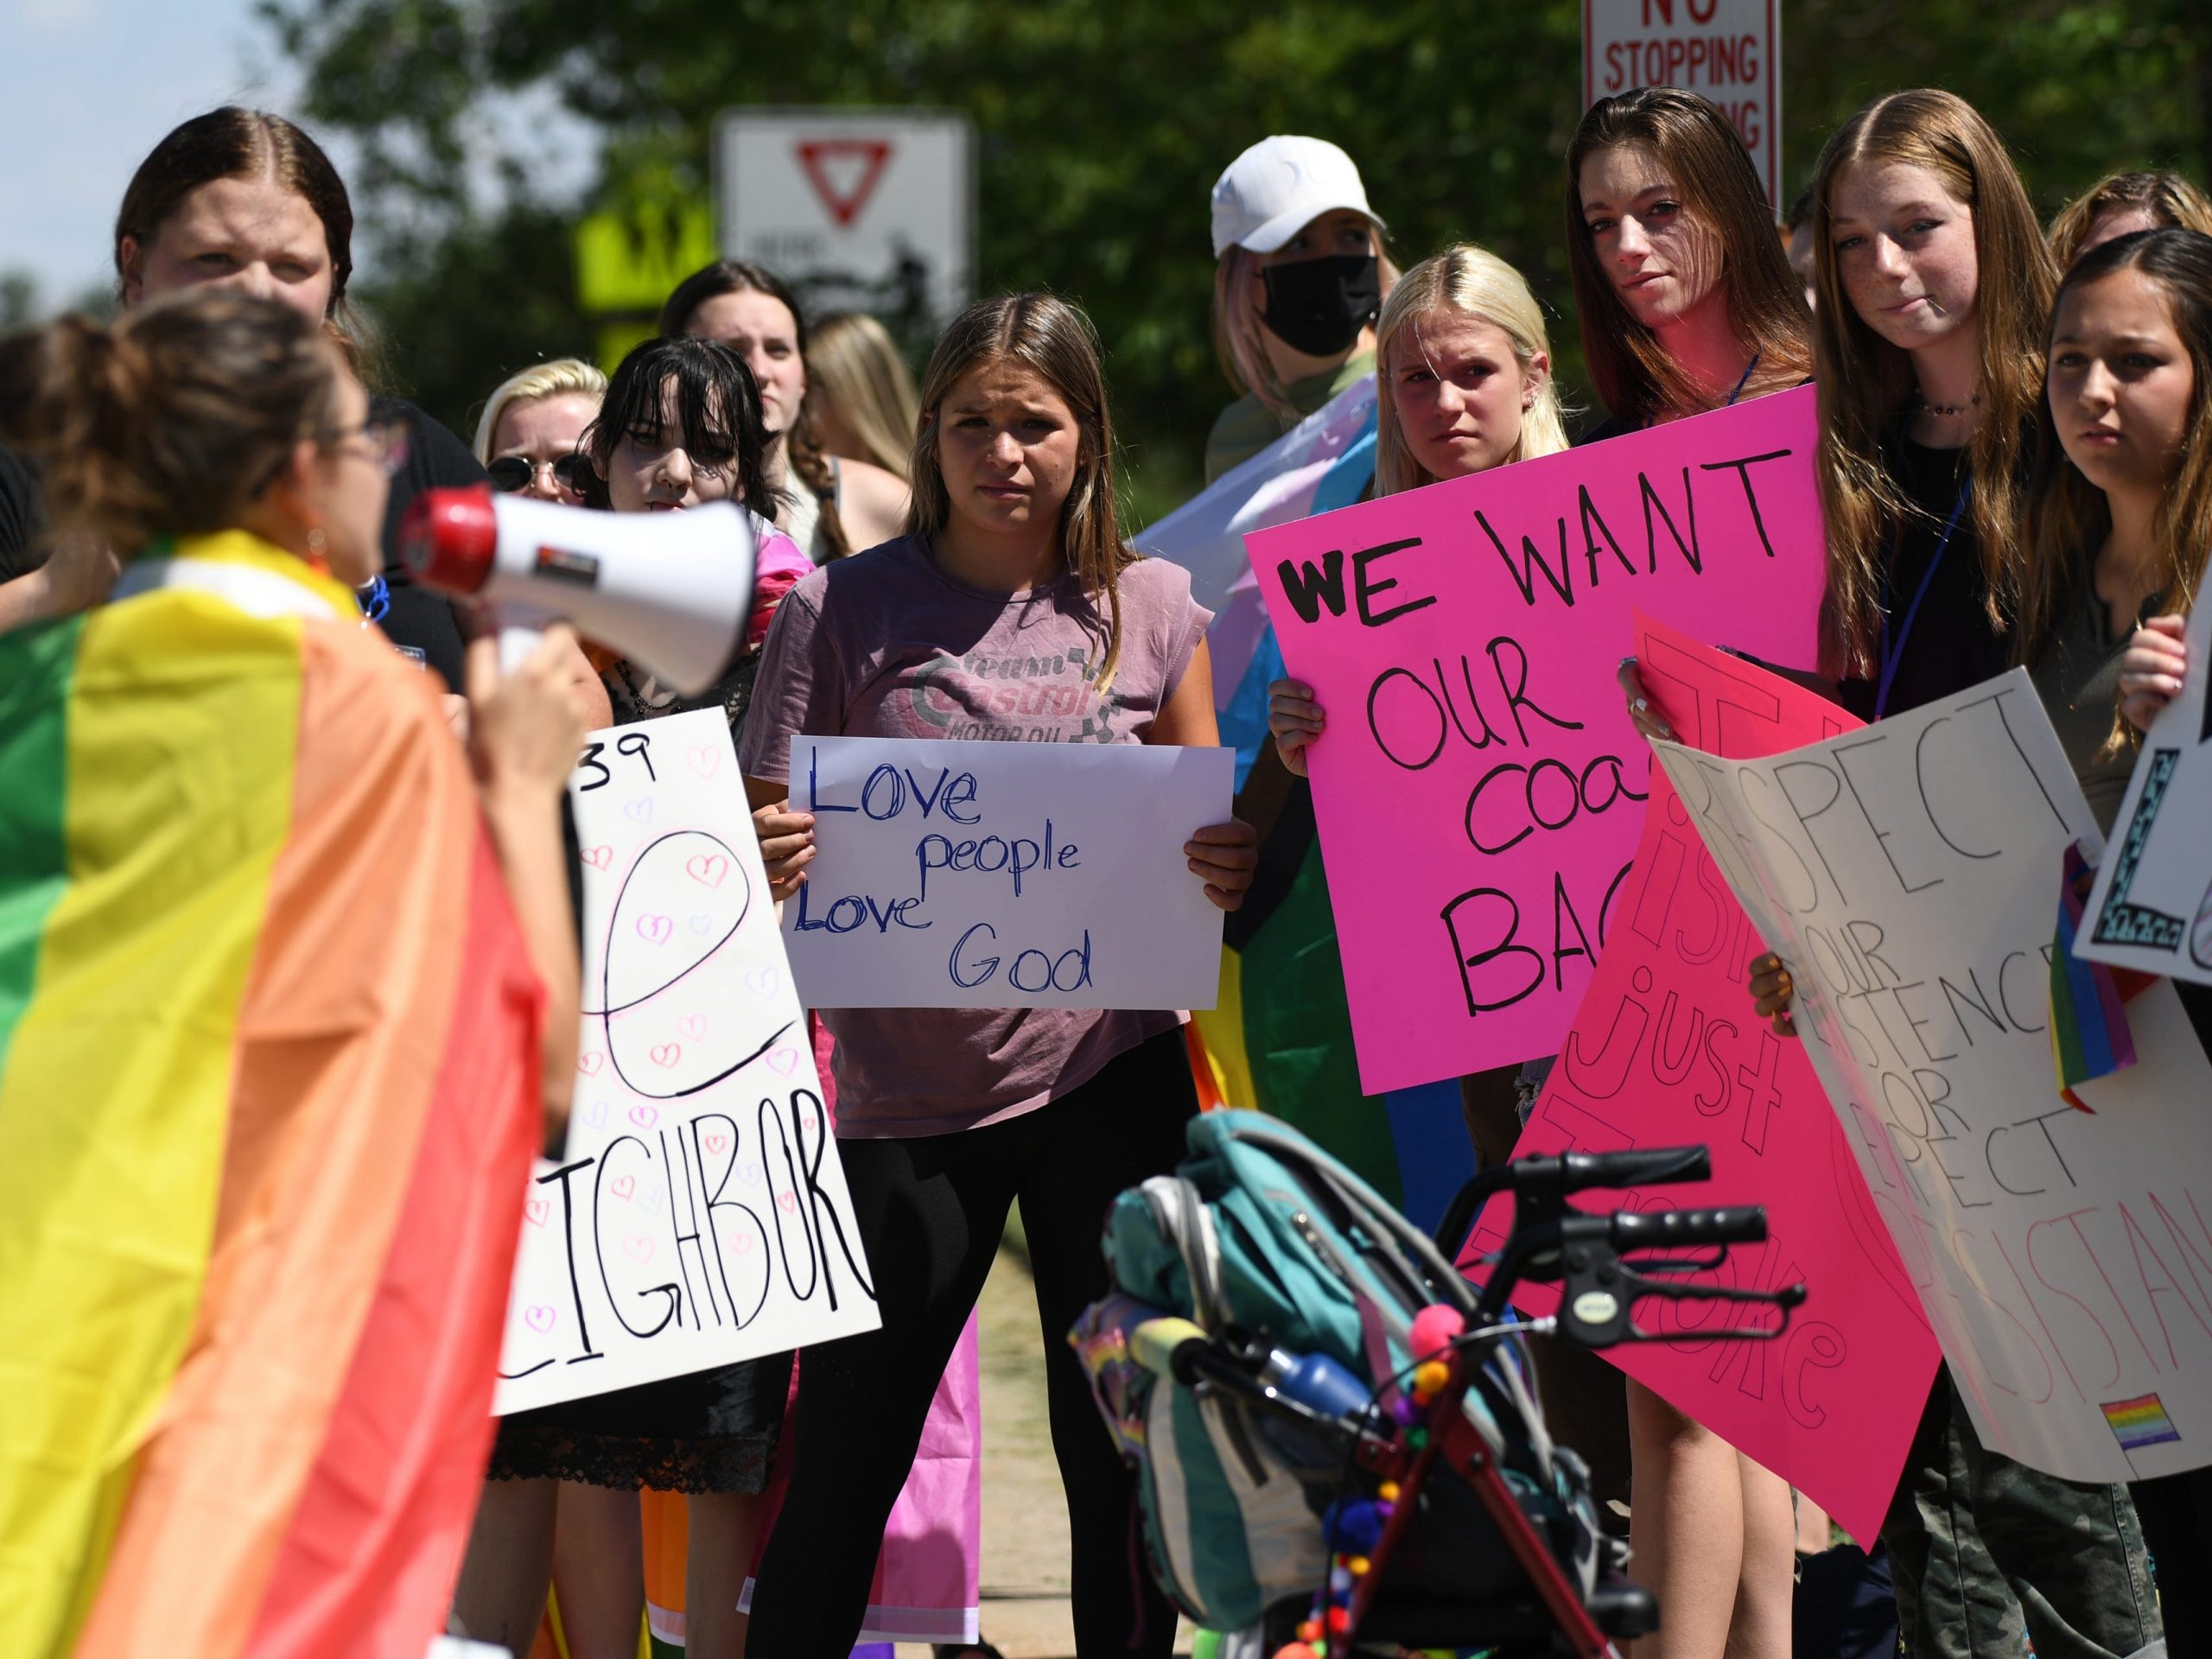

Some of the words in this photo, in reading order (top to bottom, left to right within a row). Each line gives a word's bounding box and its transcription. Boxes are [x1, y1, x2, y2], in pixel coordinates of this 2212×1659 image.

[1605, 35, 1758, 90] STOPPING
[1277, 536, 1438, 628] WE
[1473, 448, 1792, 607] WANT
[963, 653, 1066, 680] team
[915, 817, 1082, 902] people
[948, 922, 1093, 993] God
[1805, 919, 1902, 995] OUR
[1564, 965, 1783, 1157] just
[1882, 1069, 1971, 1138] OR
[496, 1089, 880, 1380] IGHBOR
